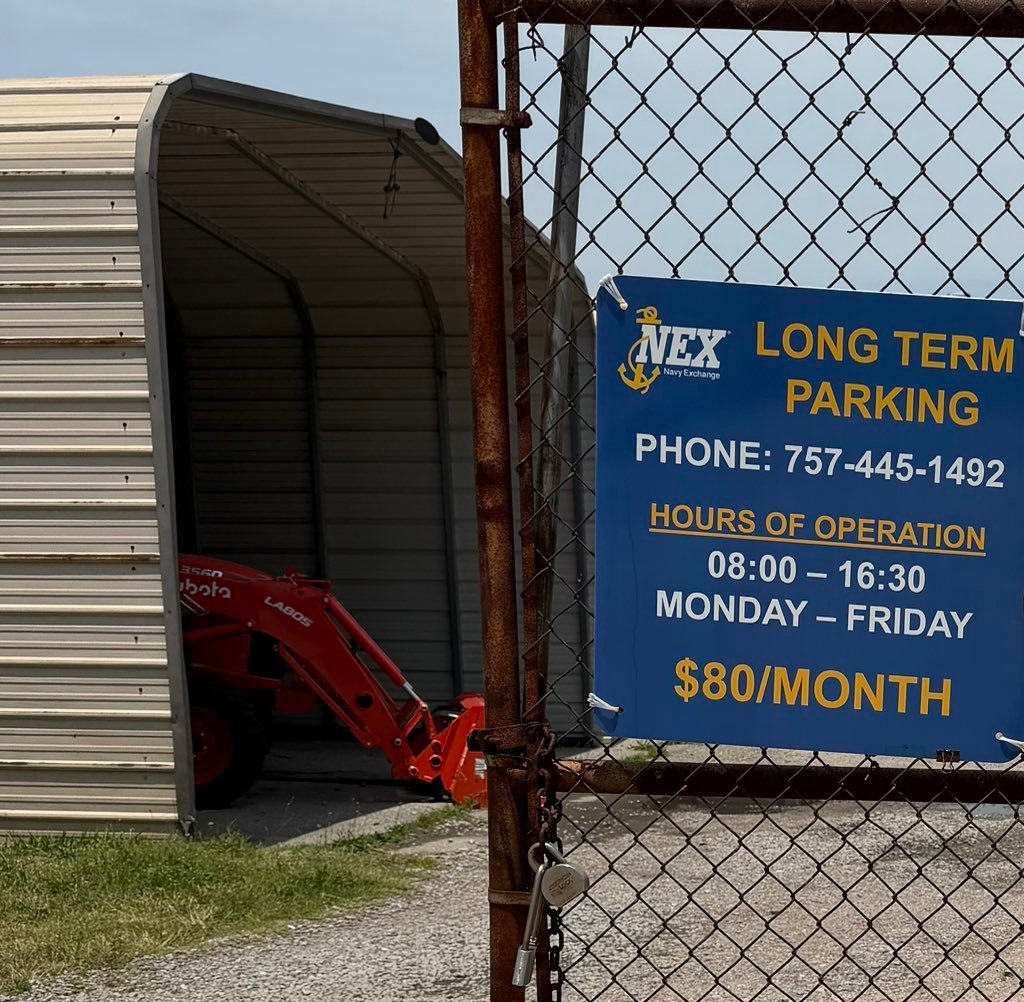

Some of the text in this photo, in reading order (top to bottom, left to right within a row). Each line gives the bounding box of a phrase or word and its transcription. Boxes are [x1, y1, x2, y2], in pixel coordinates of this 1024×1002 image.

[635, 324, 727, 369] NEX
[756, 321, 1015, 373] LONG TERM
[663, 367, 721, 380] Navy Exchange
[786, 378, 979, 426] PARKING
[636, 433, 1005, 488] PHONE: 757-445-1492
[650, 503, 986, 550] HOURS OF OPERATION
[708, 550, 797, 584] 08:00
[838, 560, 926, 593] 16:30
[263, 596, 314, 628] LA805
[656, 589, 809, 627] MONDAY
[847, 603, 974, 639] FRIDAY
[674, 657, 952, 717] $80/MONTH
